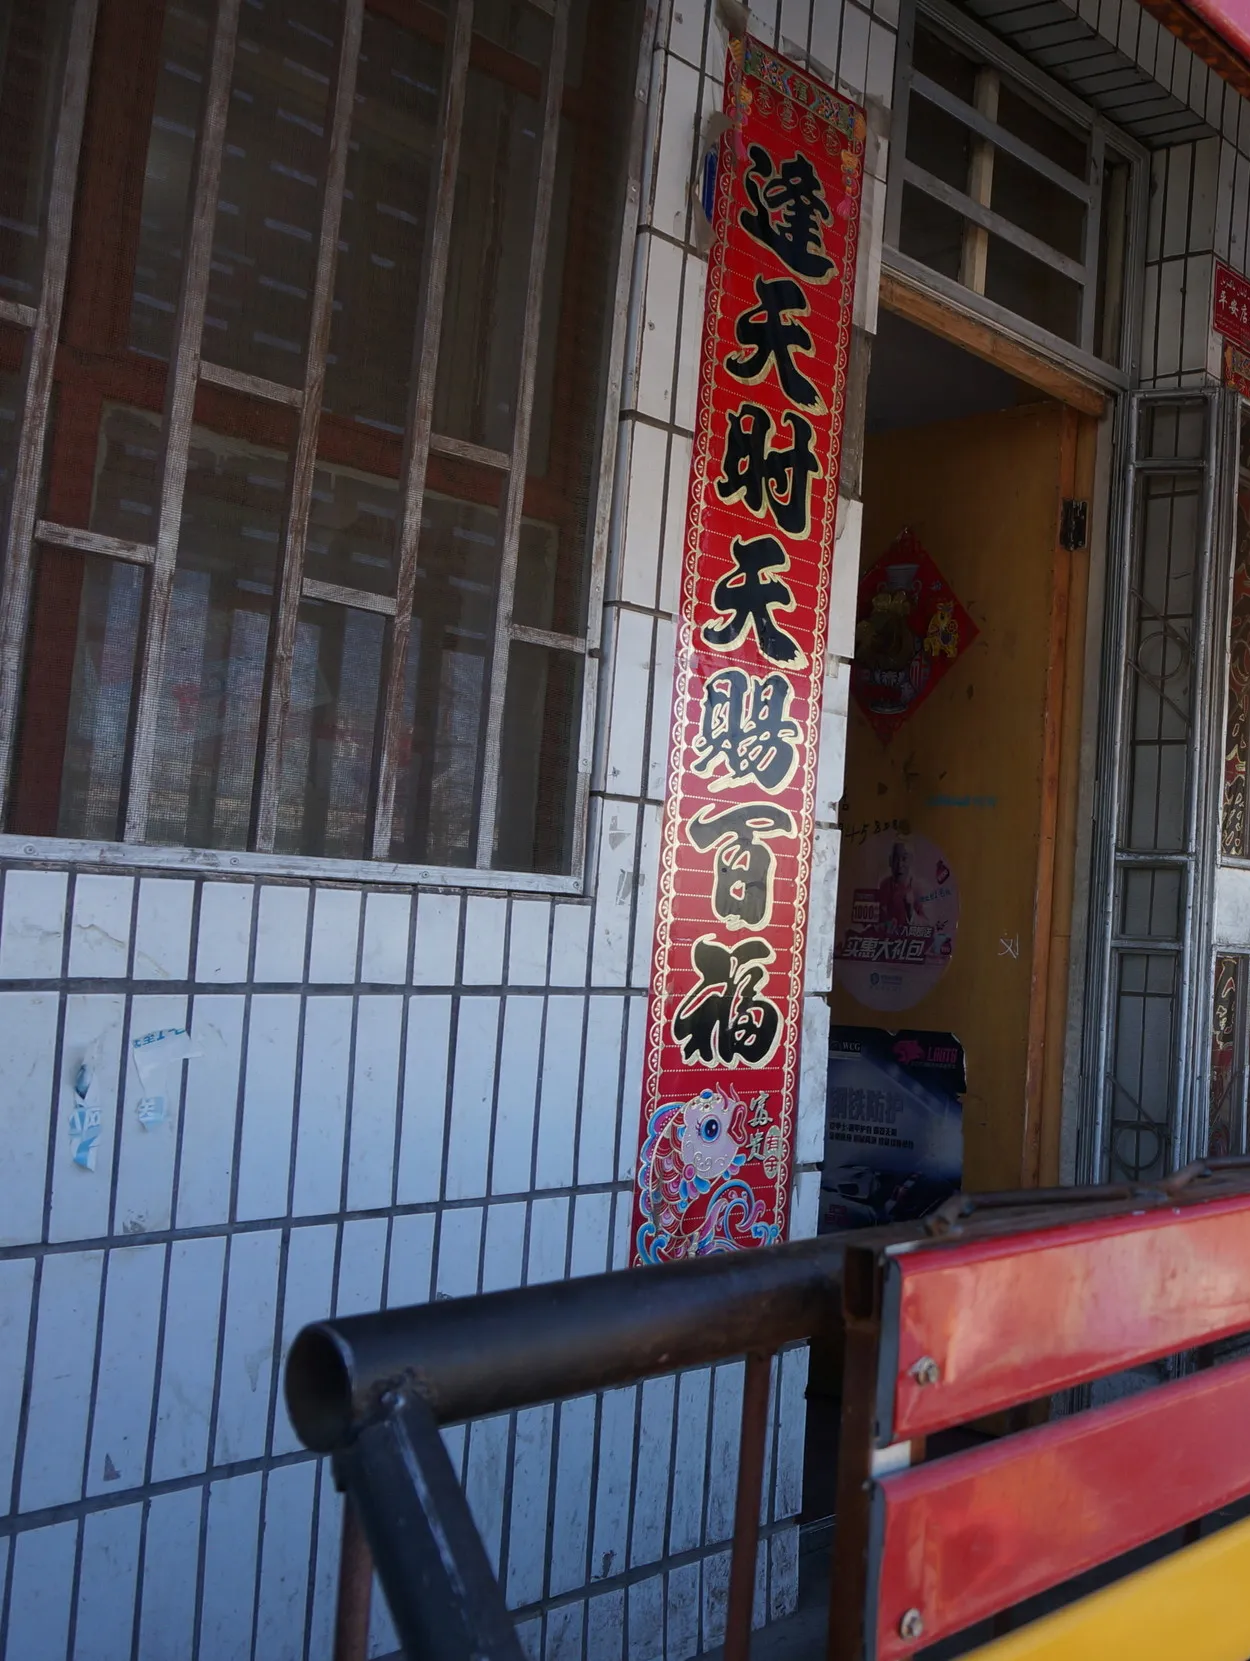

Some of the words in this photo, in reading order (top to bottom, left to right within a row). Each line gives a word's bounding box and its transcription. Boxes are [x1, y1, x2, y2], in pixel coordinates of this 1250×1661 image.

[853, 905, 875, 920] 1000
[842, 936, 927, 962] 实惠大礼包
[843, 1041, 862, 1052] WCG
